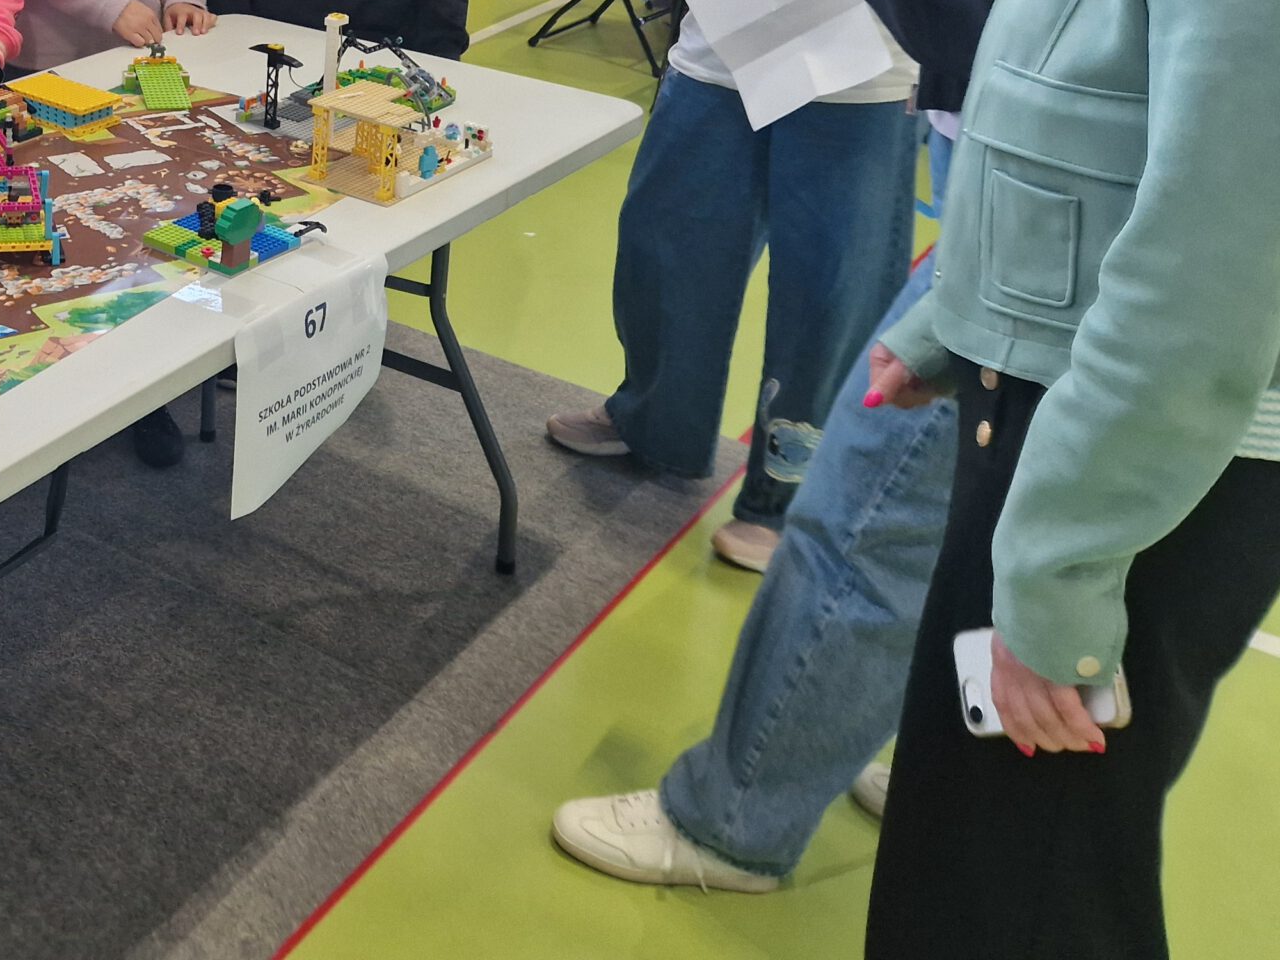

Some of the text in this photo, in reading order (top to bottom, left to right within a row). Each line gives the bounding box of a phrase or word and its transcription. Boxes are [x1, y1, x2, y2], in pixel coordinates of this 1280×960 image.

[304, 301, 328, 339] 67
[258, 394, 293, 423] SZKOŁA
[293, 356, 353, 401] PODSTAWOWA
[354, 348, 365, 364] NR
[266, 365, 364, 437] IM. MARII KONOPNICKIEJ
[285, 393, 345, 443] W ŻYRARDOWIE
